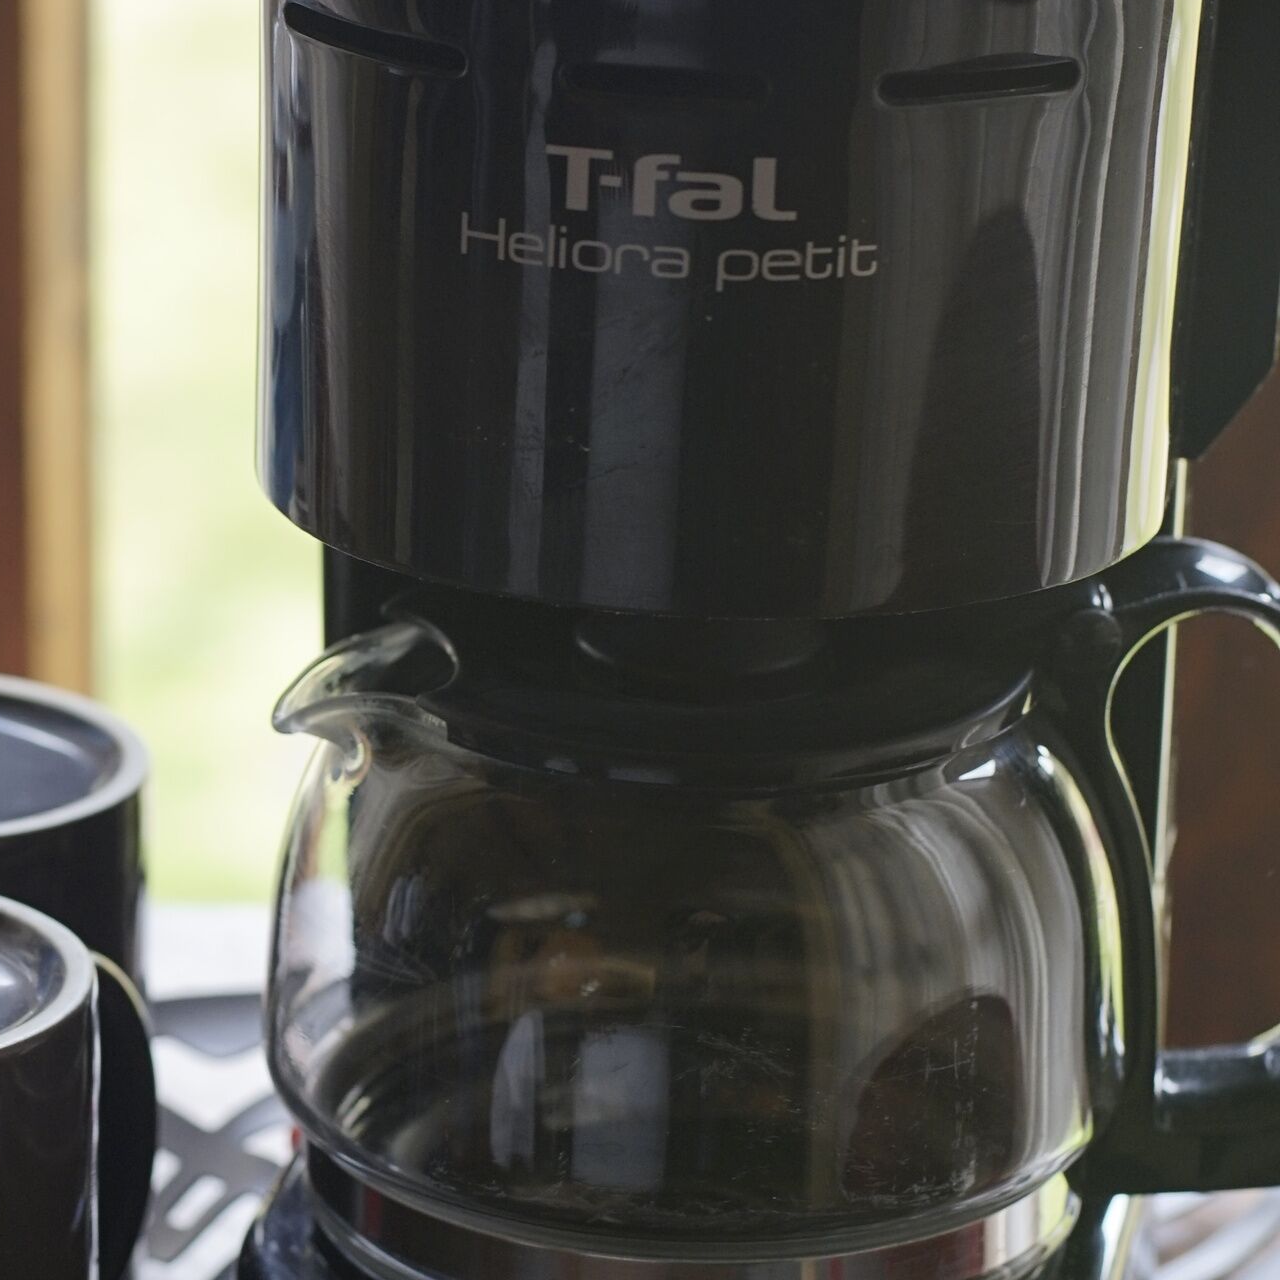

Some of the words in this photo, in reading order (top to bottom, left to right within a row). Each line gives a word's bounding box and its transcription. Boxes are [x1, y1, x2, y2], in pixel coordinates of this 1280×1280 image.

[545, 143, 798, 221] T-fal
[460, 212, 690, 279] Heliora
[715, 235, 879, 293] petit
